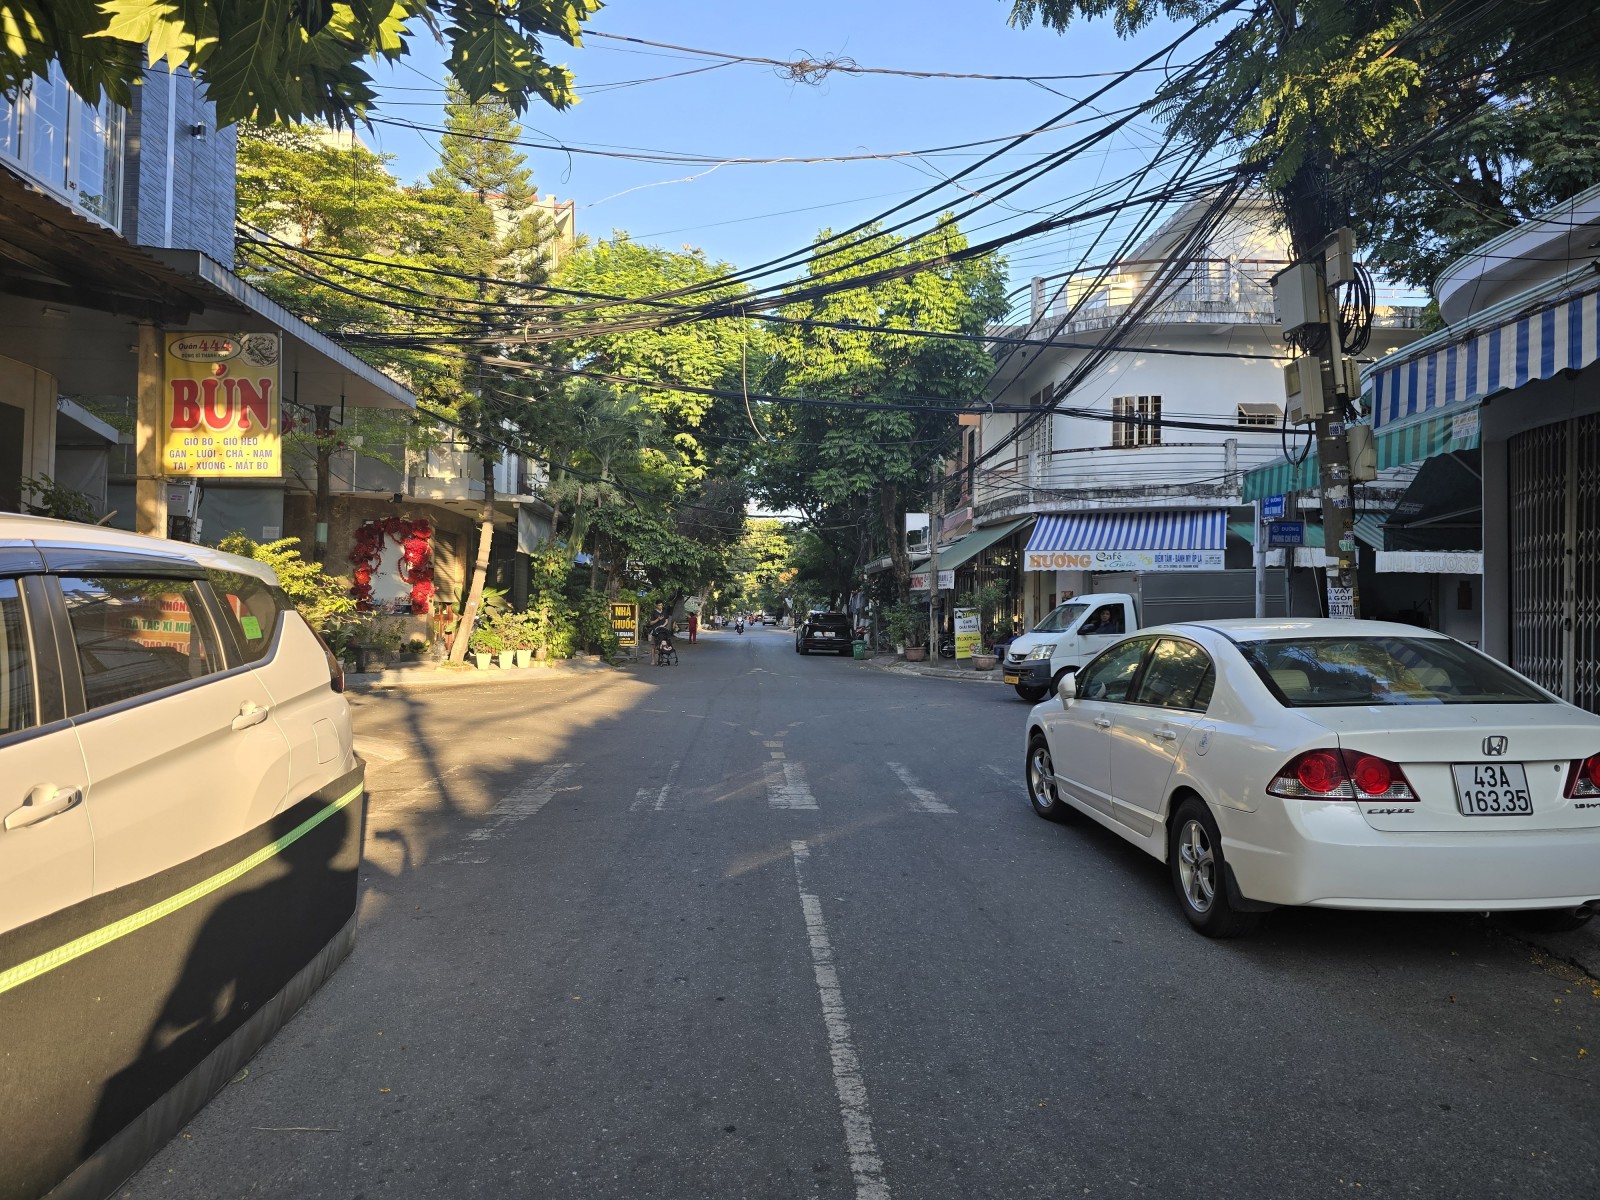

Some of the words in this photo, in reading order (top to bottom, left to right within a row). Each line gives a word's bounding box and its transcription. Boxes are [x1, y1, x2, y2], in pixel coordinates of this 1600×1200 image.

[178, 343, 197, 352] Quán
[199, 340, 231, 352] 444
[170, 364, 272, 429] BÚN
[241, 437, 258, 446] HEO
[1029, 552, 1092, 568] HƯƠNG
[1096, 552, 1122, 562] Café
[1415, 554, 1479, 572] PHƯƠNG
[615, 604, 631, 616] NHÀ
[1474, 766, 1510, 787] 43A
[1465, 789, 1529, 813] 163.35
